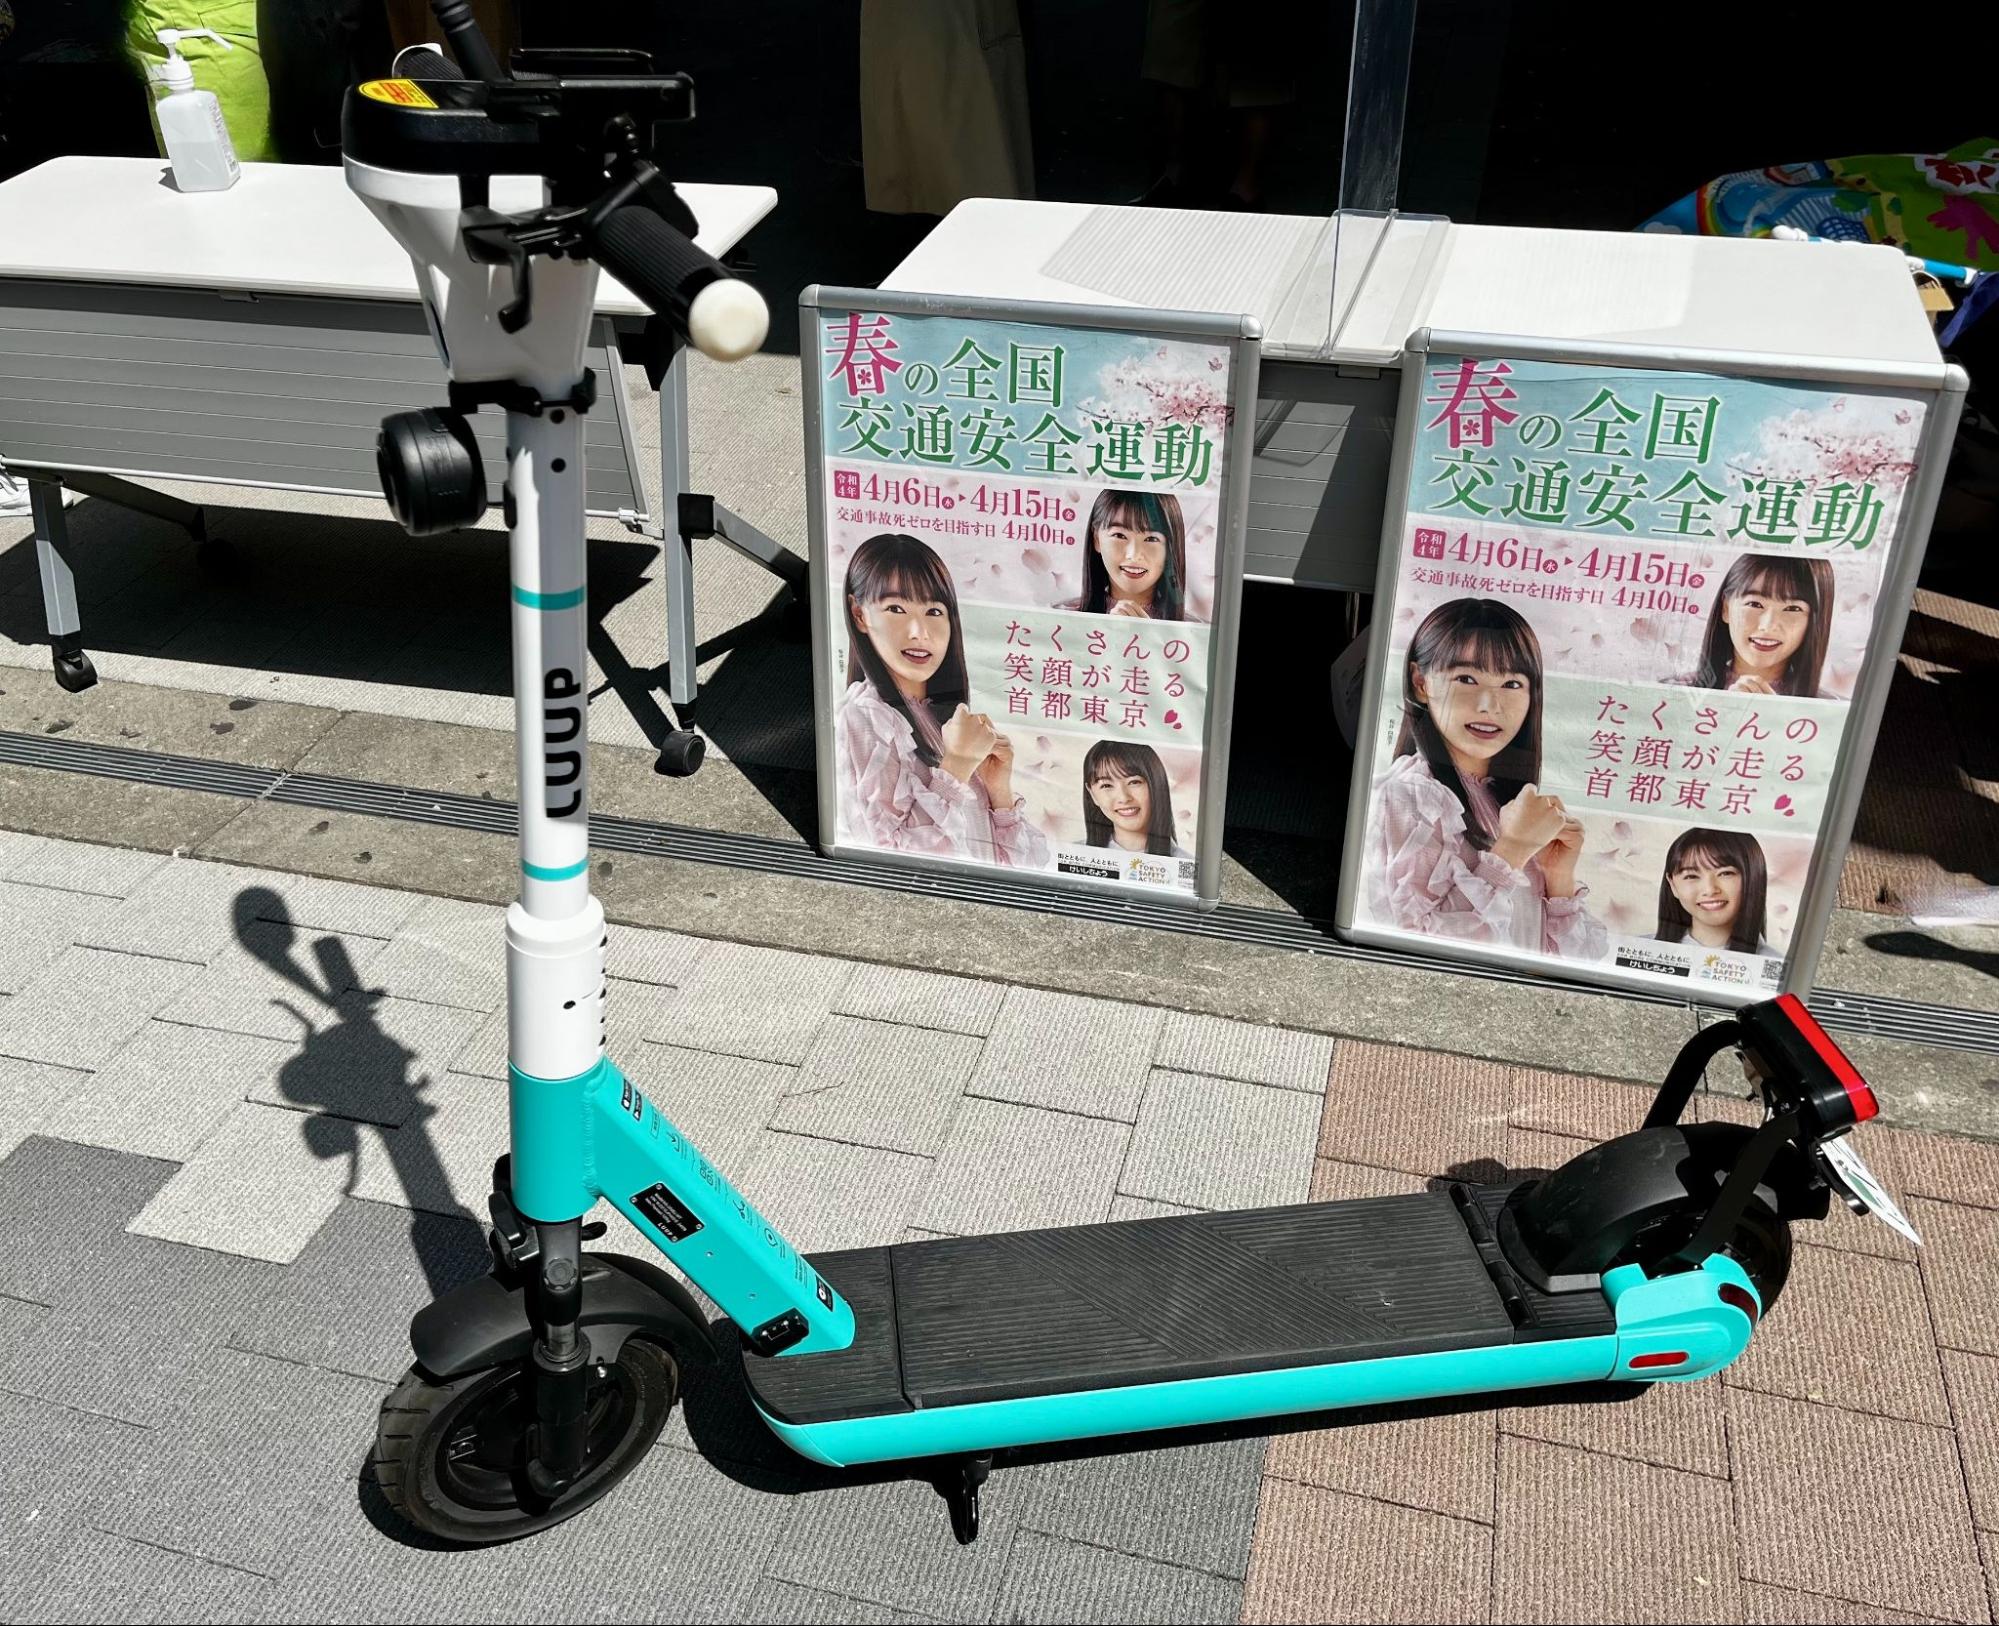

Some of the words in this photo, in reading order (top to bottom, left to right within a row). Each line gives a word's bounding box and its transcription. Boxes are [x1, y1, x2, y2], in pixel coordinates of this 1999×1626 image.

[825, 312, 1065, 408] 春の全国
[1426, 358, 1721, 466] 春の全国
[838, 397, 1214, 487] 交通安全運動
[1428, 448, 1885, 551] 交通安全運動
[1005, 620, 1190, 663] たくさんの
[1002, 652, 1186, 698] 笑顔が走る
[1003, 686, 1149, 728] 首都東京
[1596, 695, 1819, 745] たくさんの
[544, 667, 582, 818] LUUP
[1584, 730, 1806, 783] 笑顔が走る
[1582, 766, 1759, 815] 首都東京
[1138, 870, 1165, 879] SAFETY
[1139, 864, 1166, 873] TOKYO
[1712, 968, 1745, 978] SAFETY
[1715, 961, 1747, 972] TOKYO
